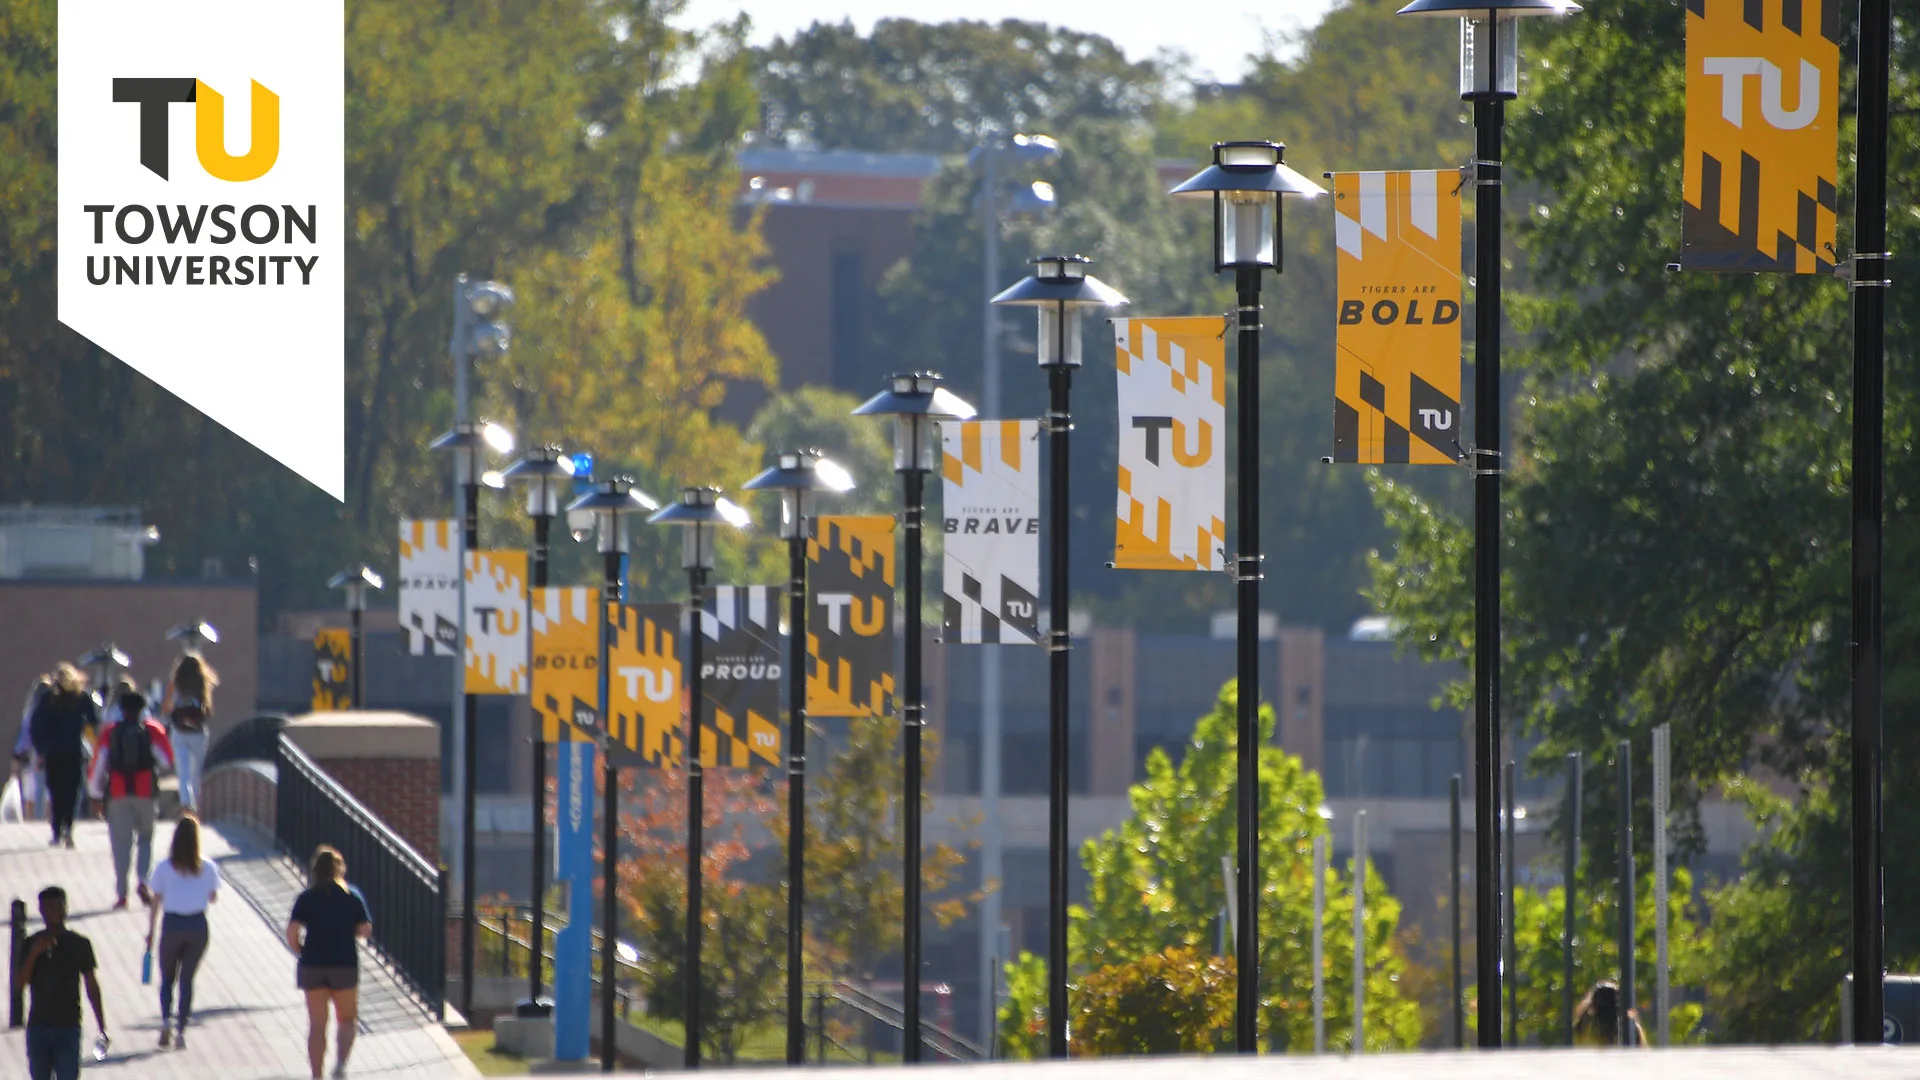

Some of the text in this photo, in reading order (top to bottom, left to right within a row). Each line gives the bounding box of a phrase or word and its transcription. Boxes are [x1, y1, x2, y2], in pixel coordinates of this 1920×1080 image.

[1704, 57, 1820, 129] TU
[1339, 300, 1460, 325] BOLD
[1419, 409, 1451, 430] TU
[1132, 416, 1212, 468] TU
[944, 518, 1040, 534] BRAVE
[473, 607, 519, 636] TU
[817, 593, 885, 636] TU
[1007, 602, 1032, 618] TU
[535, 655, 598, 669] BOLD
[700, 664, 781, 680] PROUD
[618, 666, 673, 702] TU
[754, 732, 775, 747] TU
